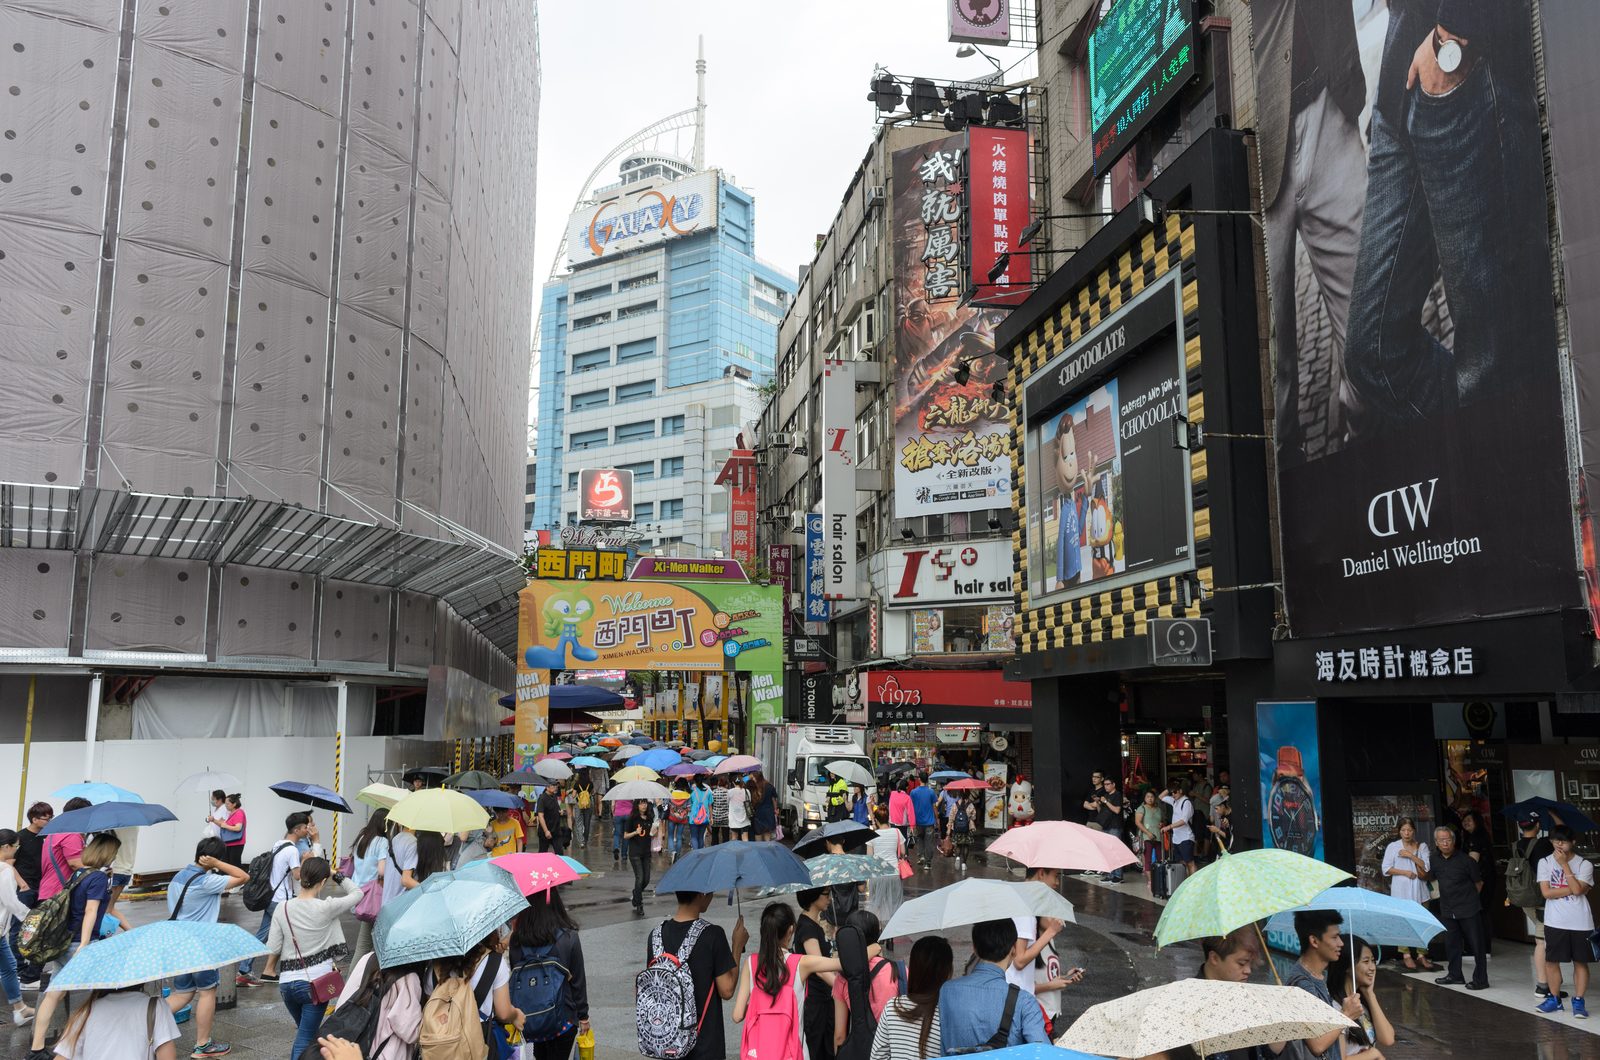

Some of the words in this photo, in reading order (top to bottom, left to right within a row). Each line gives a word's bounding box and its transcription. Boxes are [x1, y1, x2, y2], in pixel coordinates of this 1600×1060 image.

[588, 190, 700, 257] GALAXY
[1147, 386, 1161, 402] AND
[946, 467, 992, 480] 全新改版
[1366, 477, 1440, 538] DW
[832, 513, 847, 541] hair
[537, 548, 628, 582] 西門町
[653, 561, 688, 574] Xi-Men
[689, 563, 725, 575] Walker
[832, 545, 847, 584] salon
[1342, 551, 1390, 578] Daniel
[1391, 533, 1482, 568] Wellington
[954, 579, 985, 596] hair
[600, 591, 674, 616] Welcome
[593, 606, 697, 649] 西門町
[602, 646, 655, 660] XIMEN-WALKER
[807, 690, 816, 719] TOUGH
